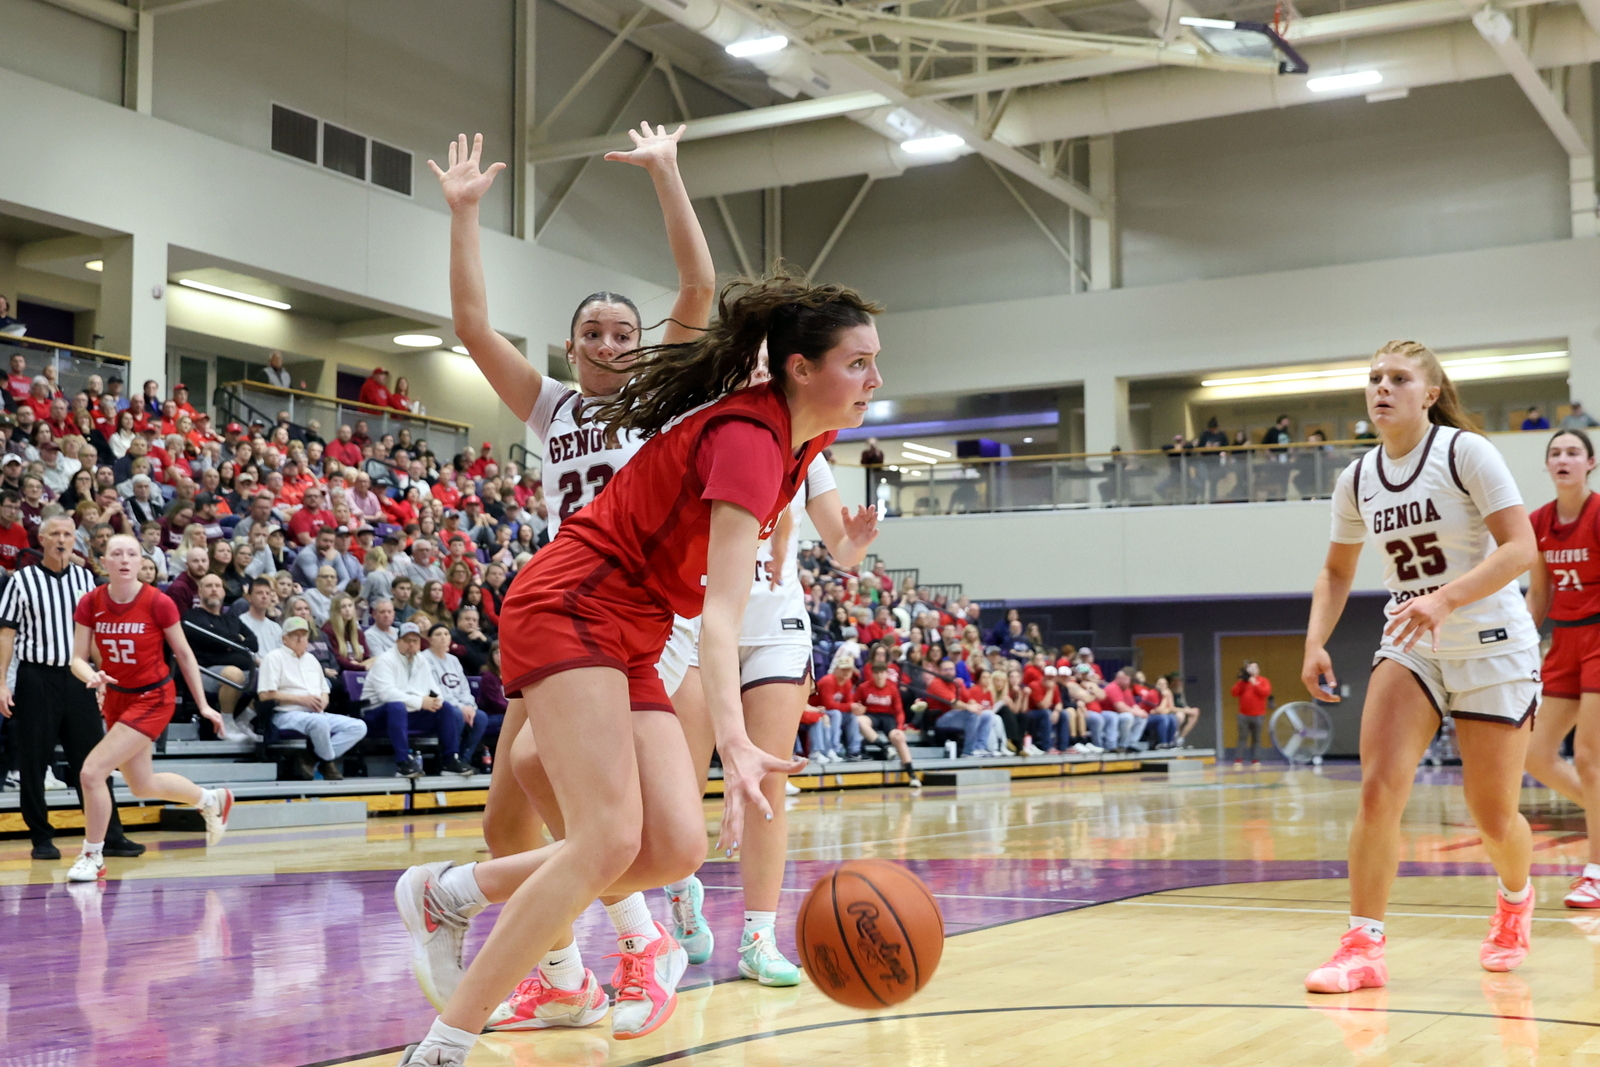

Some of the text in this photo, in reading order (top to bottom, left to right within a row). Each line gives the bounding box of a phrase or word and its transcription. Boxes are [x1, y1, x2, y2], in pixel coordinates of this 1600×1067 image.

[1373, 498, 1442, 534] GENOA
[1385, 531, 1448, 582] 25
[96, 621, 146, 634] BELLEVUE
[102, 639, 137, 664] 32
